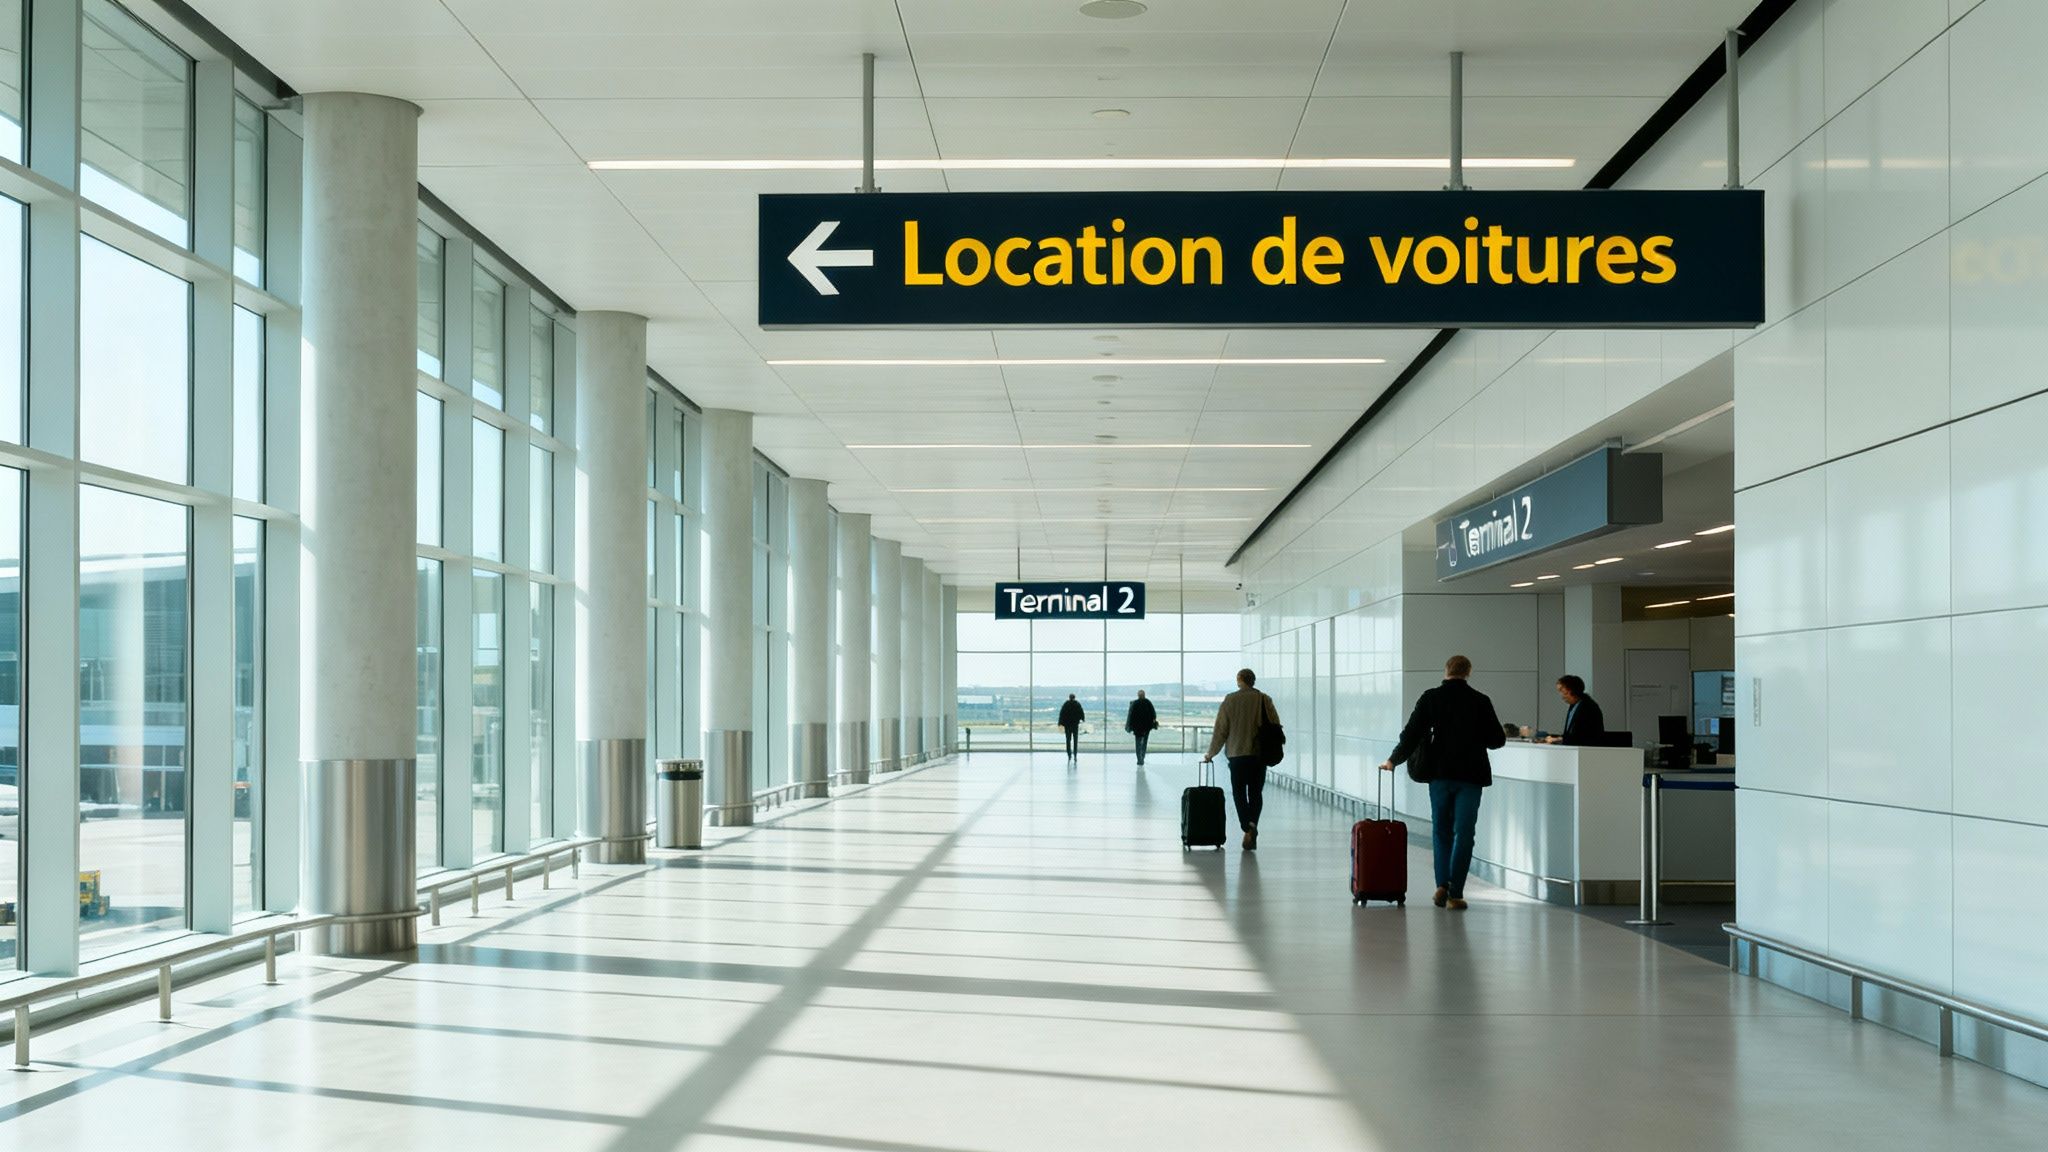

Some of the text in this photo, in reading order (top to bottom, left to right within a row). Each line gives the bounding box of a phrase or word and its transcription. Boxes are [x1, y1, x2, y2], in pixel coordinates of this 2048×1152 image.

[904, 215, 1677, 287] Location de voitures
[1521, 495, 1533, 540] 2
[1117, 586, 1136, 614] 2
